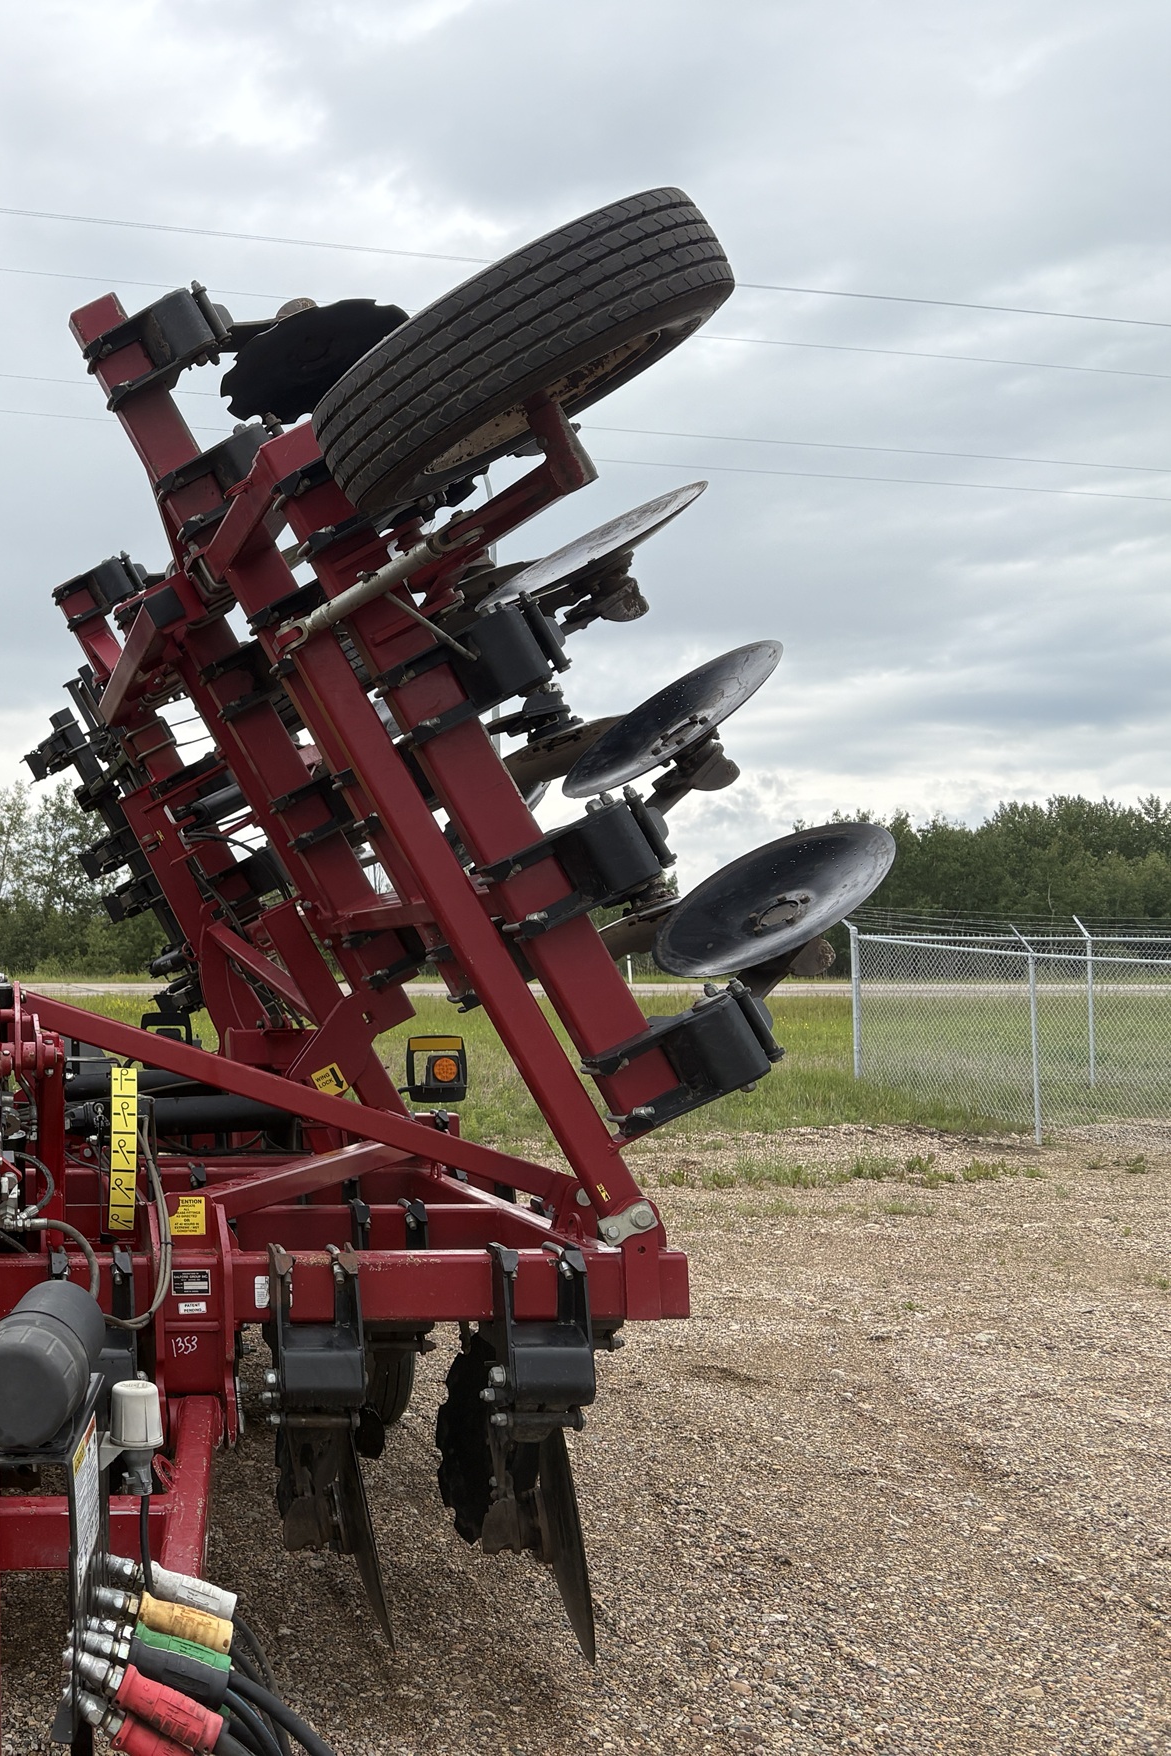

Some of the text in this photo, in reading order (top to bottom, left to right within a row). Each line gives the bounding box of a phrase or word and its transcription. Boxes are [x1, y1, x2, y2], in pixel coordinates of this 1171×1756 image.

[315, 1072, 330, 1082] WING
[318, 1078, 334, 1089] LOCK
[171, 1335, 198, 1358] 1353
